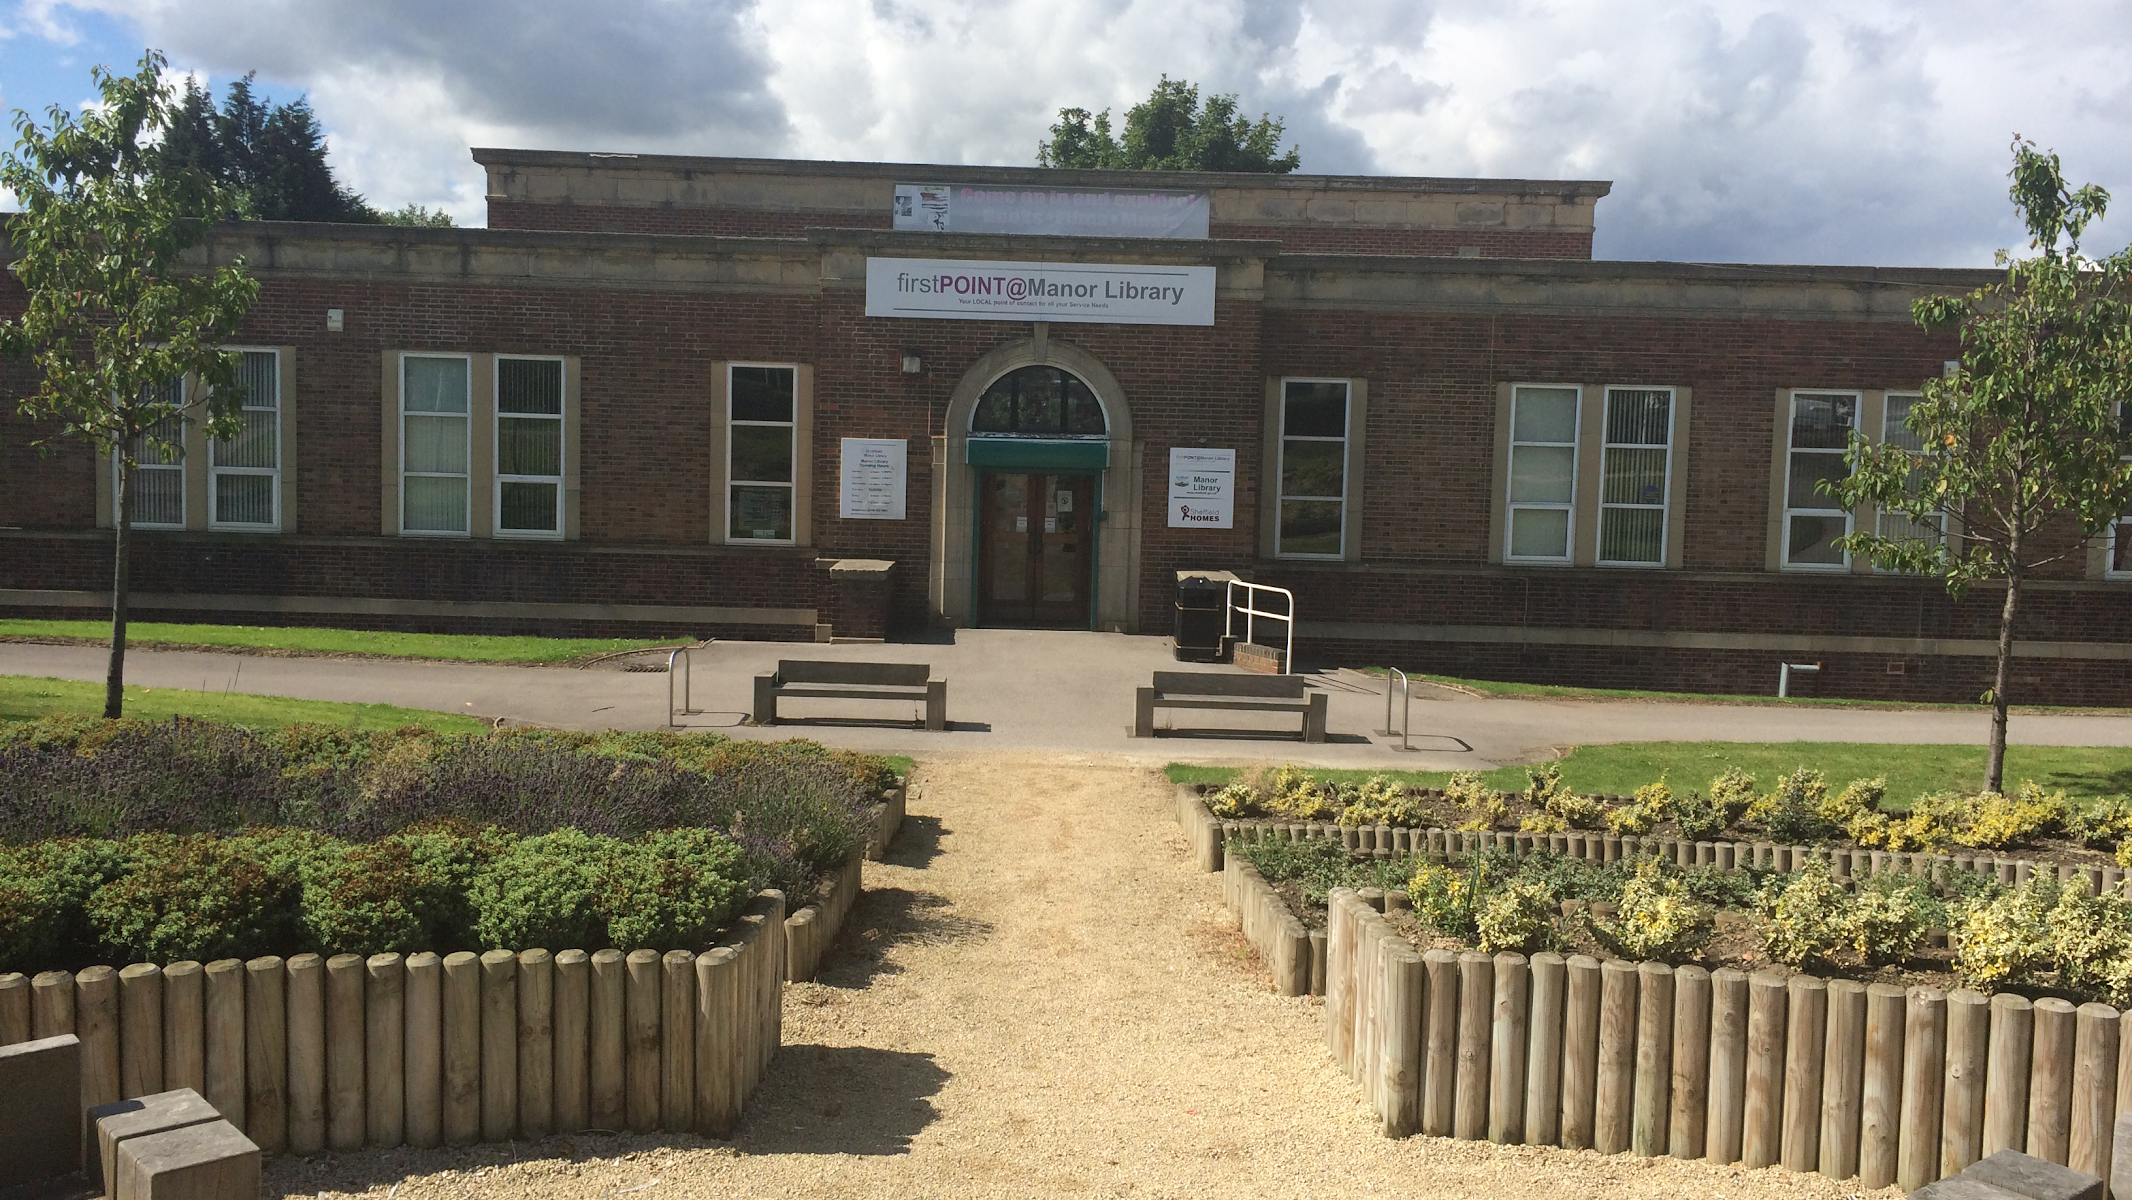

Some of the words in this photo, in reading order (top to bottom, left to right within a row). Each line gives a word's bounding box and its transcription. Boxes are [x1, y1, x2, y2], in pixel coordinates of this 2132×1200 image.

[961, 187, 1016, 203] Come
[1073, 191, 1110, 206] and
[897, 272, 1098, 301] firstPOINT@Manor
[1105, 280, 1184, 305] Library
[1193, 476, 1218, 484] Manor
[1193, 484, 1221, 493] Library
[1190, 508, 1220, 516] Sheffield
